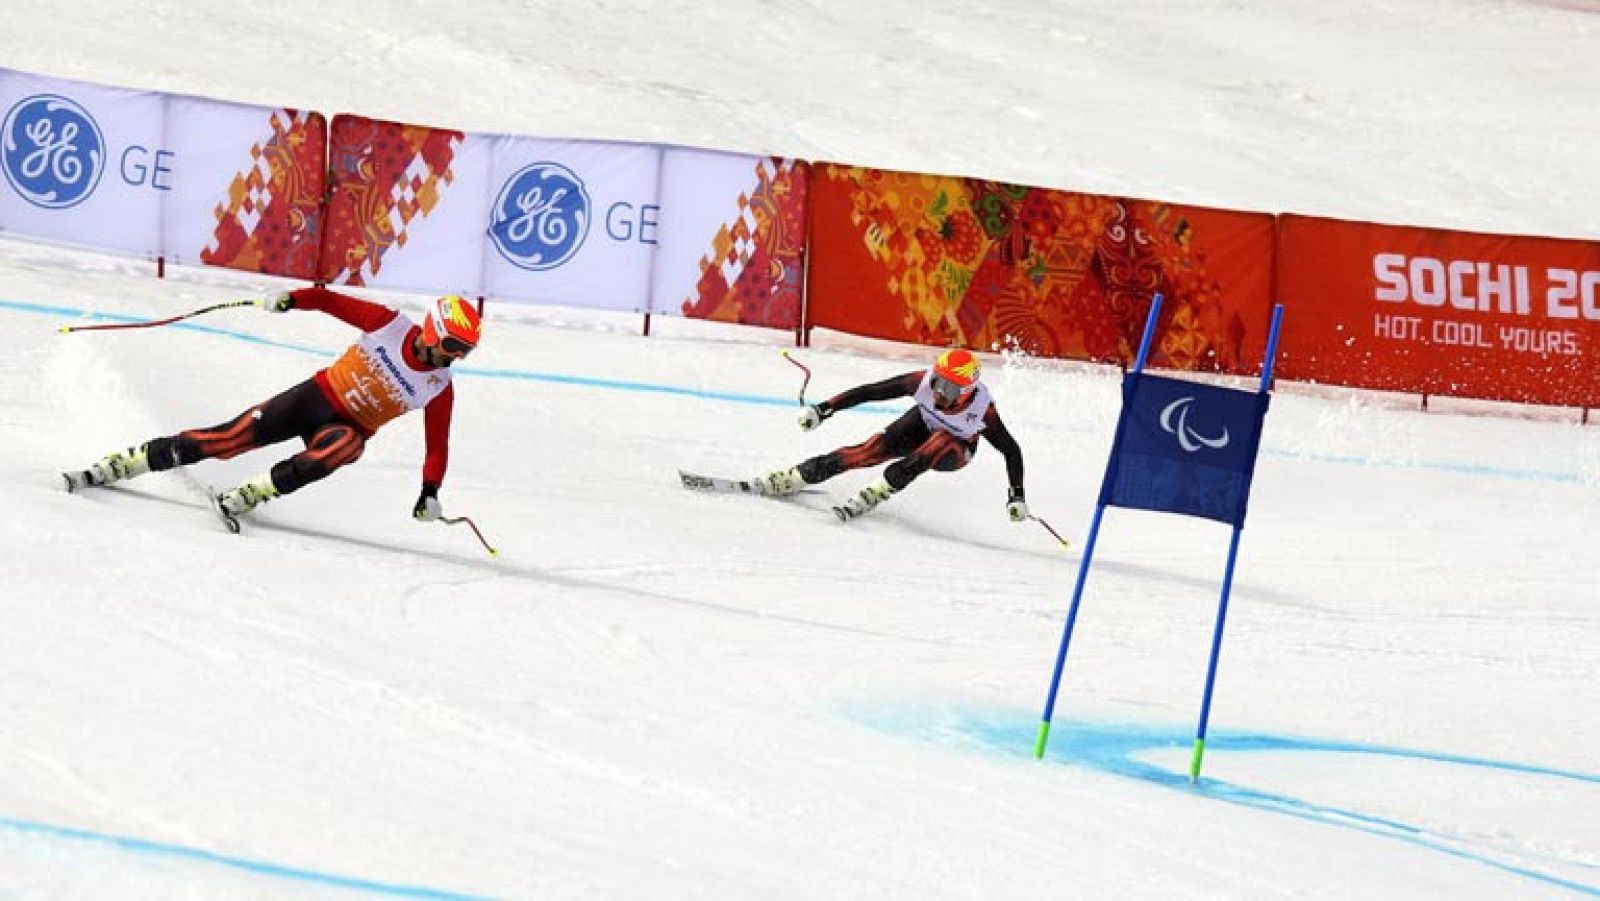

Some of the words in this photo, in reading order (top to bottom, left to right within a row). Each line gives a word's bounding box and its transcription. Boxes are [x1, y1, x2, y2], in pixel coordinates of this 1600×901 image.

[121, 145, 175, 191] GE
[606, 201, 660, 245] GE
[1374, 253, 1529, 316] SOCHI
[375, 345, 416, 397] Panasonic
